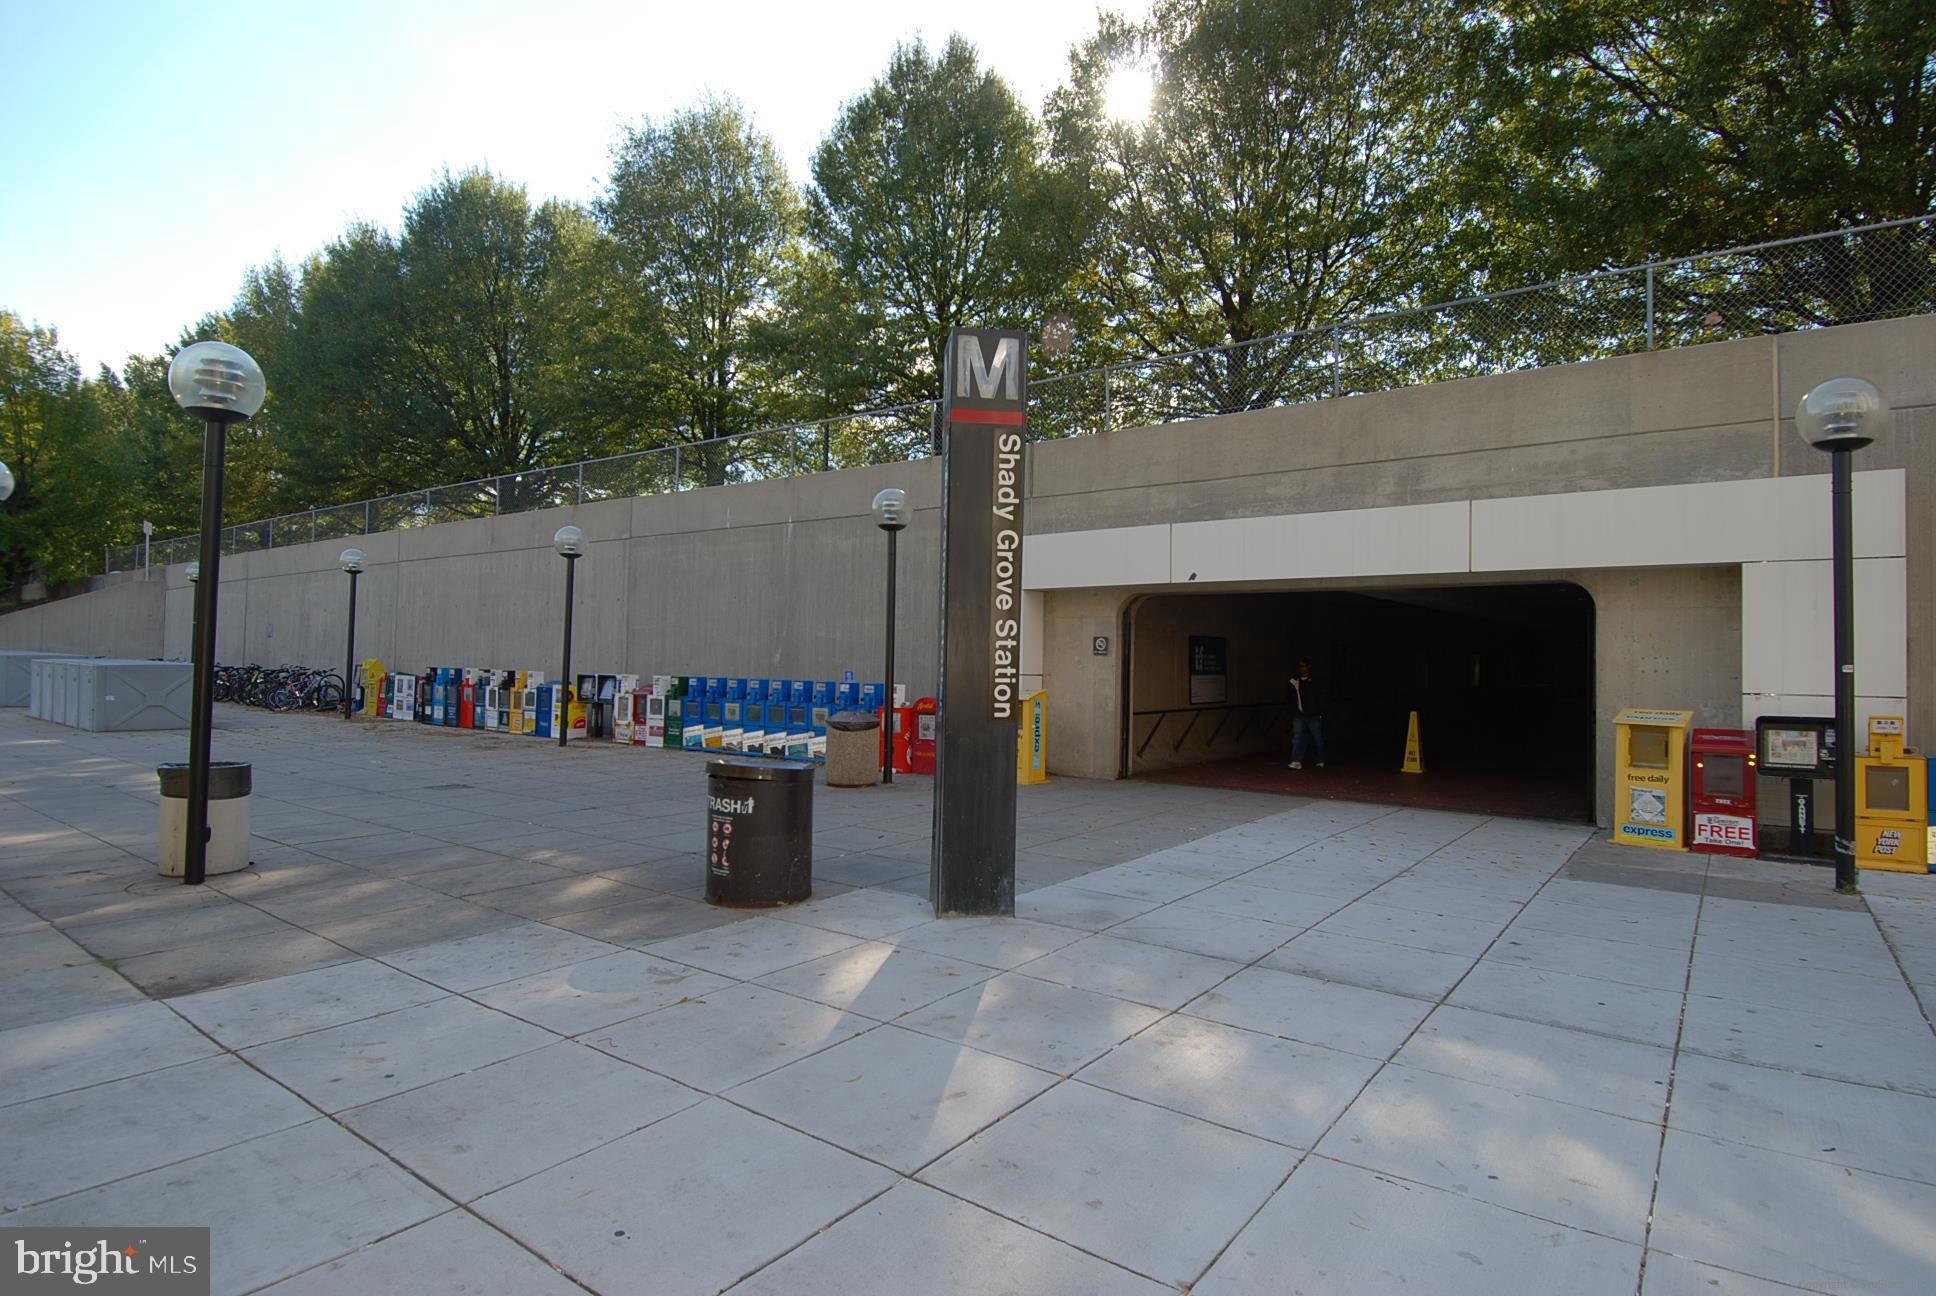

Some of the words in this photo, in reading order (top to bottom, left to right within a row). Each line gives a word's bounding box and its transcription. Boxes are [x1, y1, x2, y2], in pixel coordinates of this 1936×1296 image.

[957, 334, 1020, 401] M
[993, 433, 1021, 521] Shady
[995, 530, 1020, 611] Grove
[993, 618, 1018, 718] Station
[1627, 773, 1646, 782] free
[1647, 774, 1670, 784] daily
[707, 795, 741, 814] TRASH
[1623, 825, 1673, 838] express
[1698, 823, 1750, 840] FREE
[1881, 829, 1903, 839] NEW
[1703, 836, 1723, 844] Take
[1725, 838, 1744, 846] One!
[1877, 838, 1900, 846] YORK
[1874, 846, 1898, 854] POST
